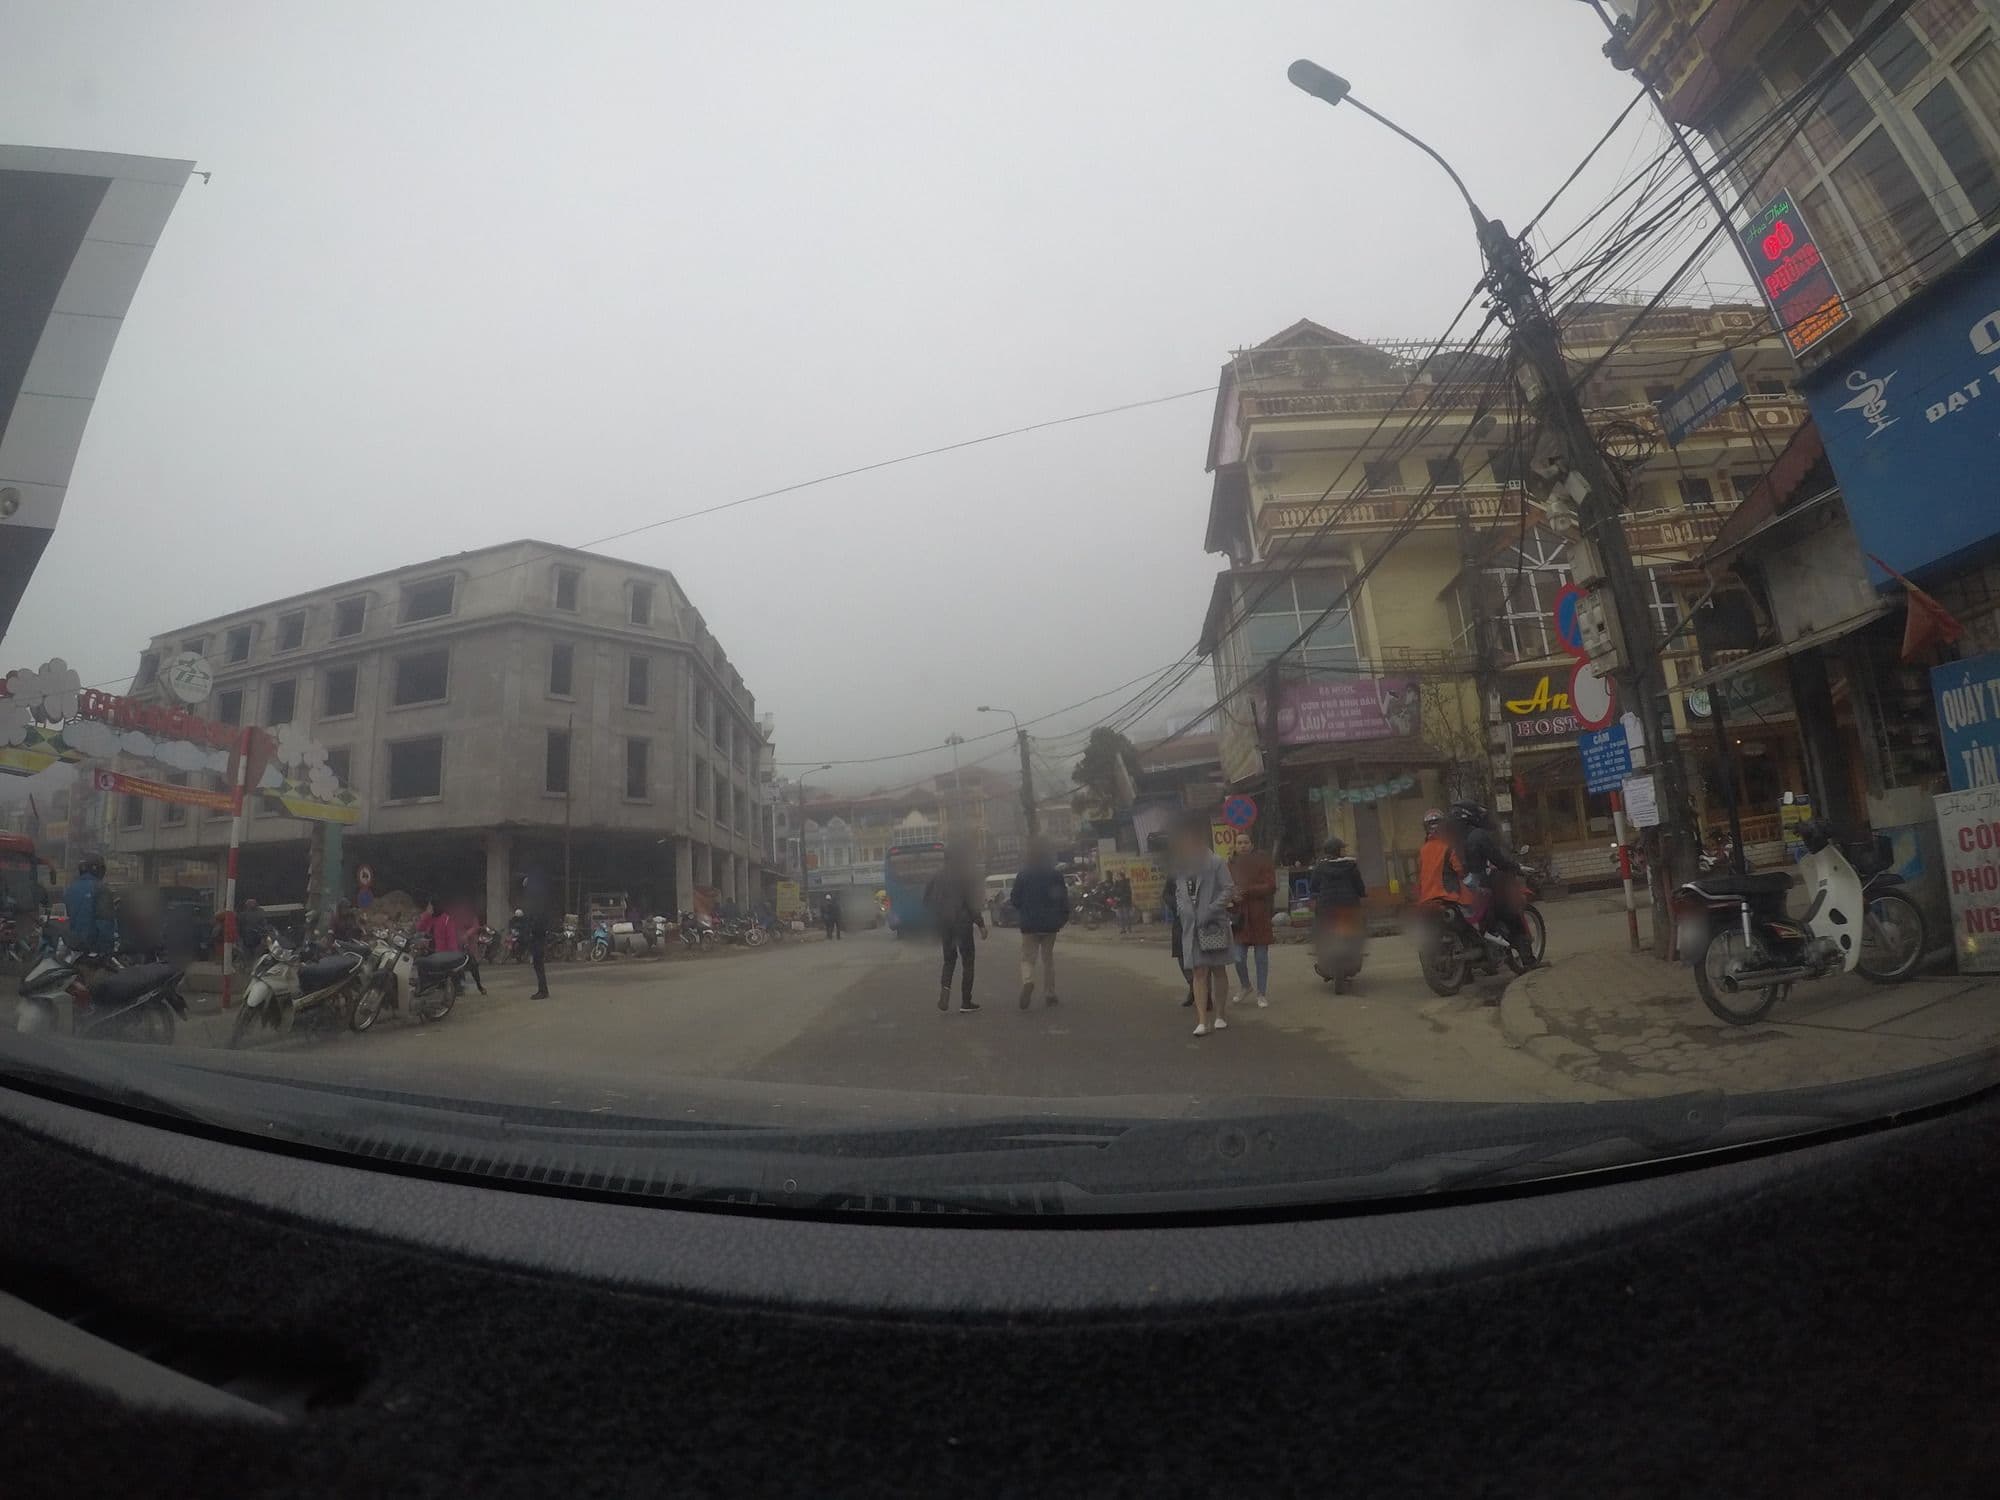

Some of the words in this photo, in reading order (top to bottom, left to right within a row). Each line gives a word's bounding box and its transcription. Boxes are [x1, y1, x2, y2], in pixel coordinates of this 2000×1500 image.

[1925, 379, 1982, 423] ĐẠT
[1505, 675, 1571, 715] An
[1516, 716, 1585, 736] HOST
